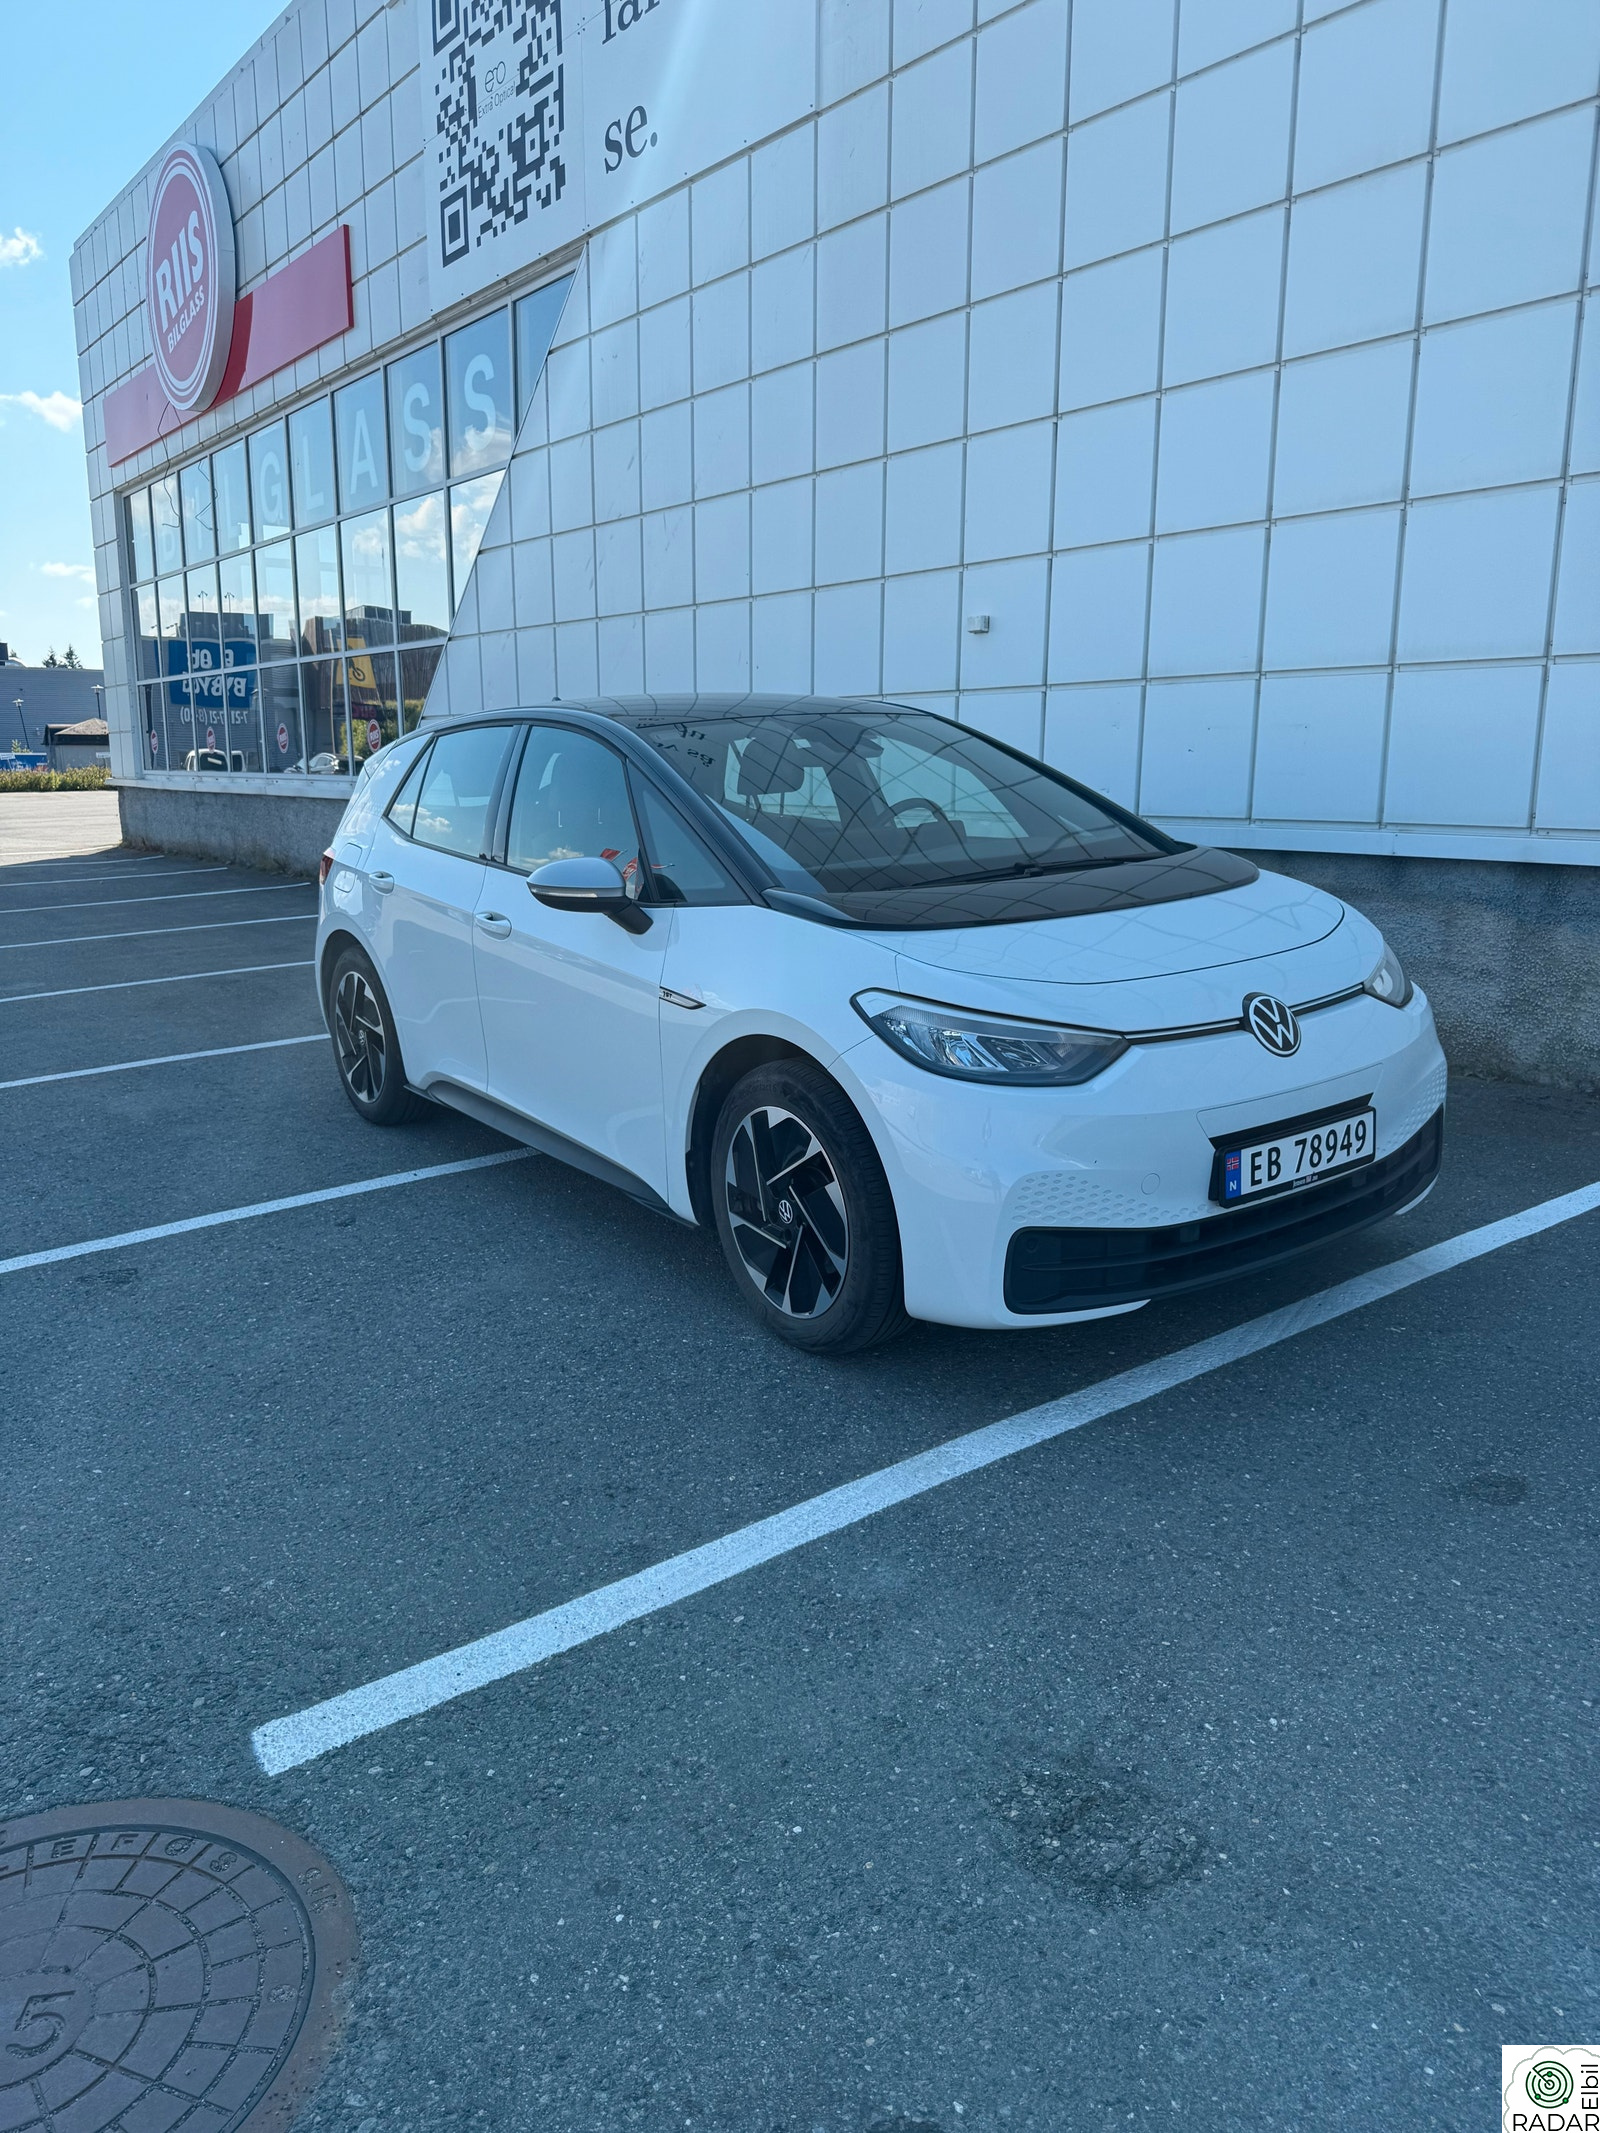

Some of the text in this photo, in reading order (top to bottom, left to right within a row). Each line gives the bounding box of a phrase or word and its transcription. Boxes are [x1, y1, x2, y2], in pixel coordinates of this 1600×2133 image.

[478, 81, 516, 119] Extra Optical
[604, 104, 658, 175] se.
[156, 210, 204, 334] RIIS
[168, 285, 205, 354] BILGLASS
[1229, 1119, 1368, 1192] N EB 78949
[6, 1990, 76, 2059] 5
